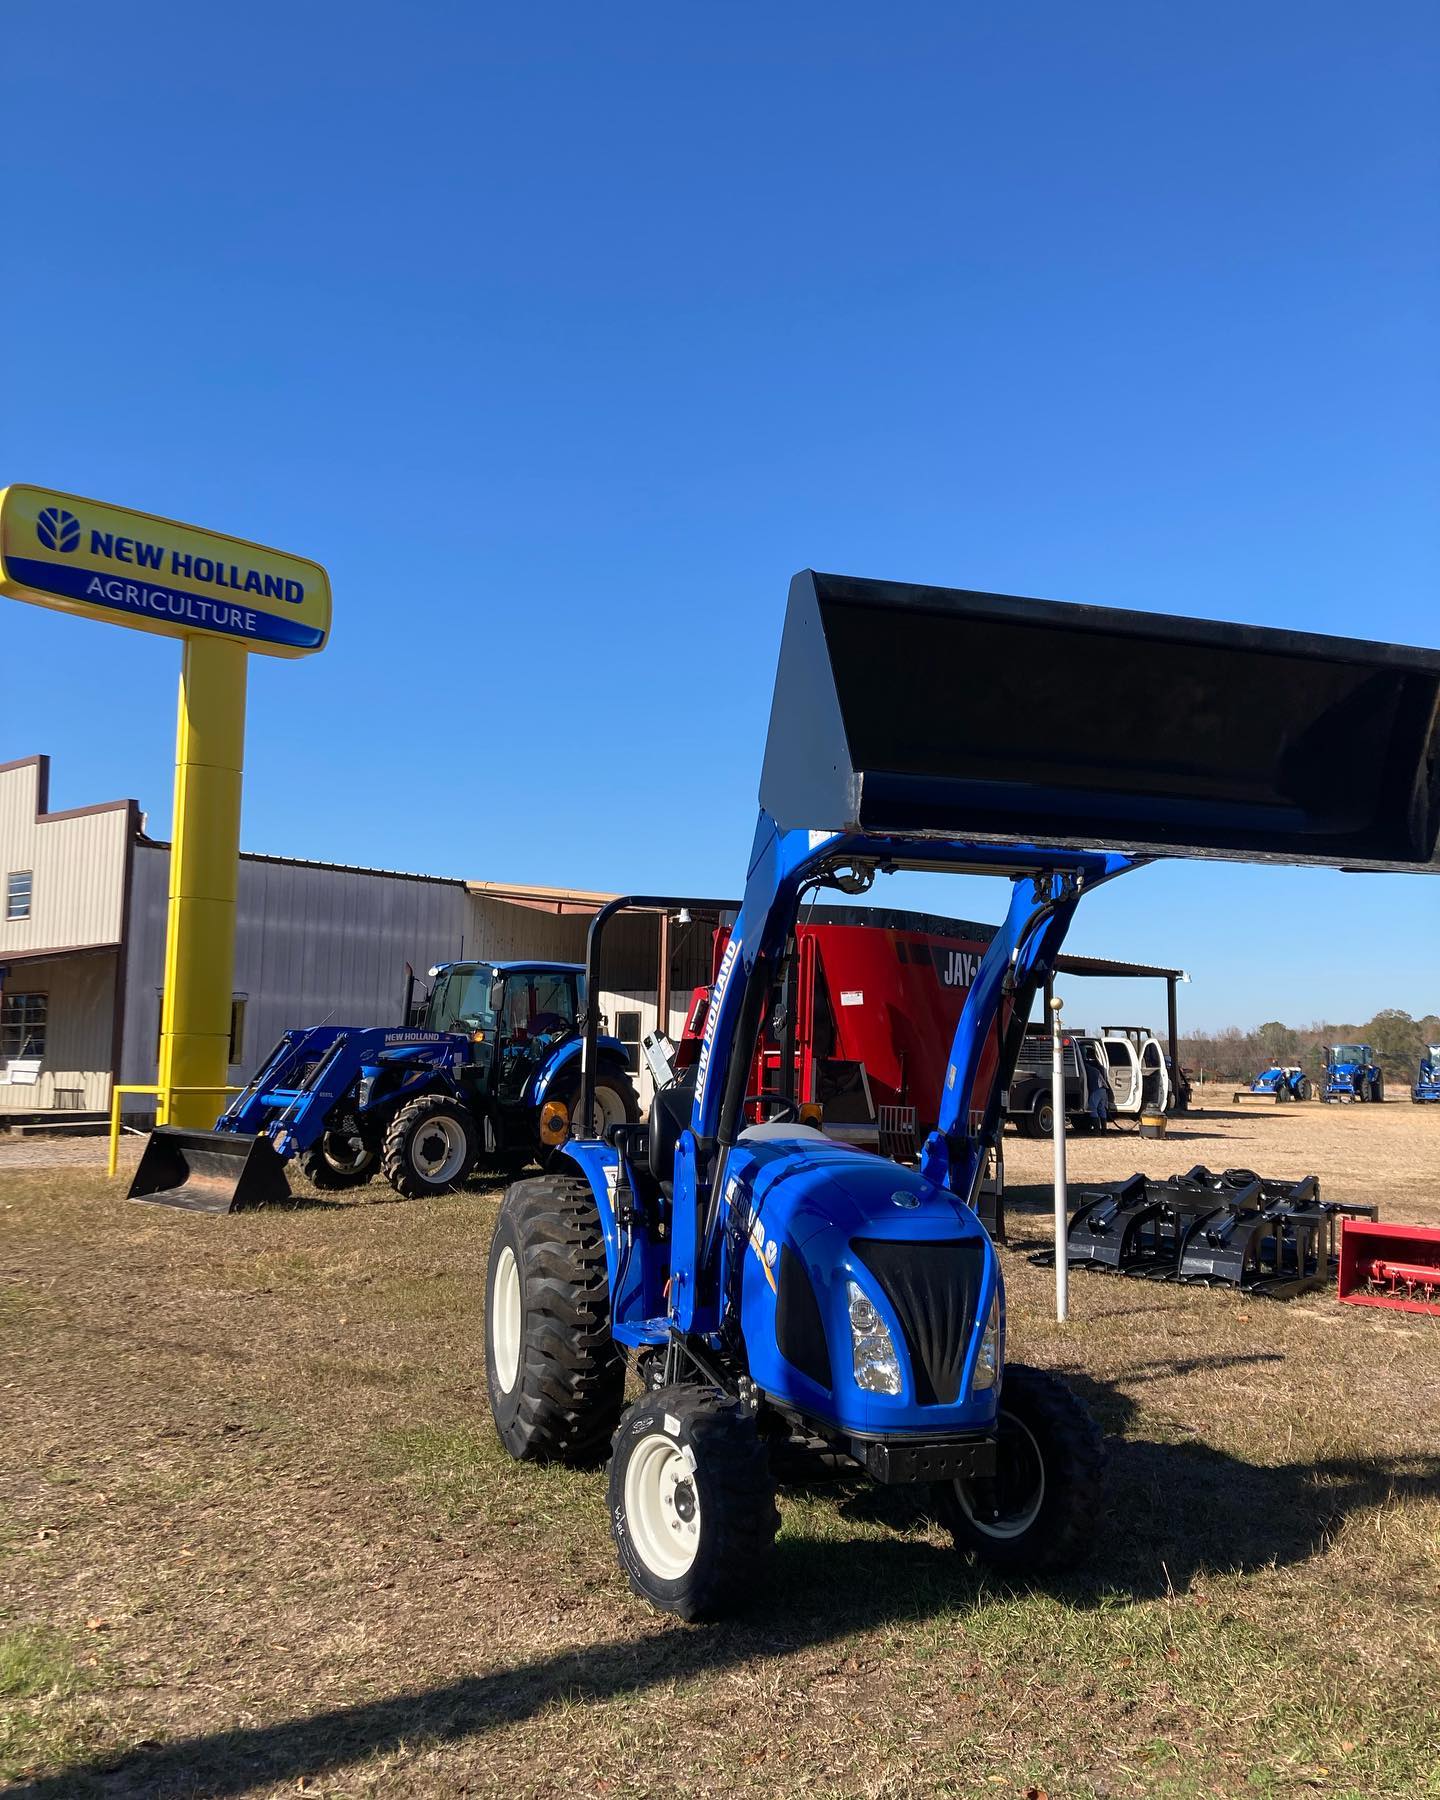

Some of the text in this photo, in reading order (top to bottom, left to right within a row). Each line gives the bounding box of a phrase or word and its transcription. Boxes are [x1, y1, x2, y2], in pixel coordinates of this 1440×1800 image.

[91, 529, 304, 605] NEW HOLLAND
[87, 576, 257, 632] AGRICULTURE
[384, 1032, 440, 1042] NEW HOLLAND
[694, 940, 737, 1101] NEW HOLLAND
